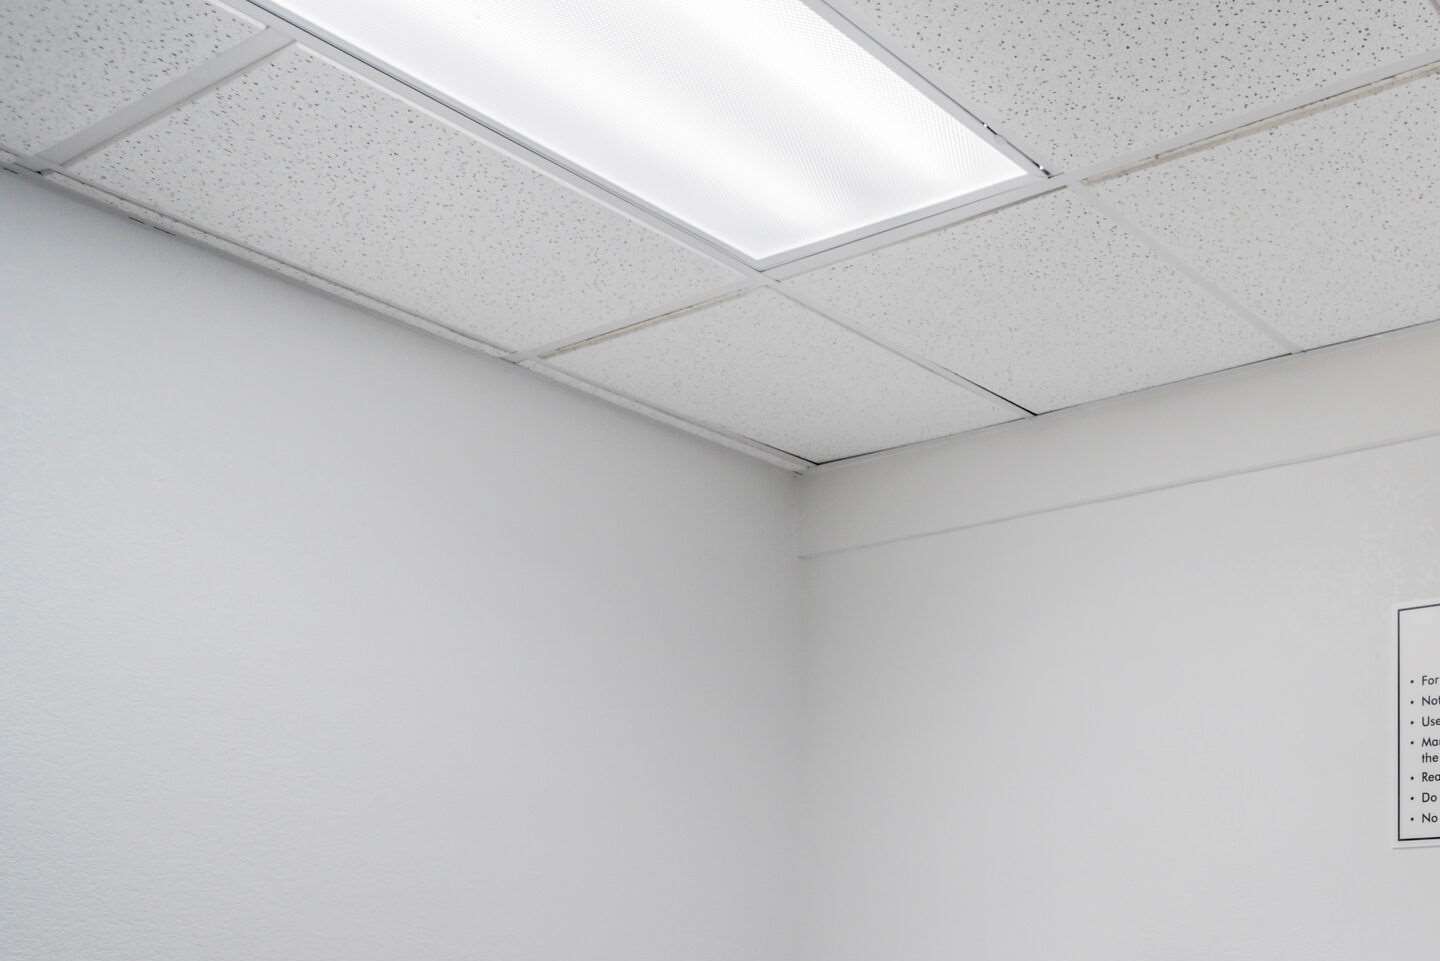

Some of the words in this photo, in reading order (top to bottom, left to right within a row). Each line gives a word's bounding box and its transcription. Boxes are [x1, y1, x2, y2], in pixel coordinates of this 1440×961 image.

[1422, 674, 1440, 686] For
[1422, 751, 1440, 764] the
[1422, 791, 1438, 804] Do
[1422, 812, 1439, 824] No
